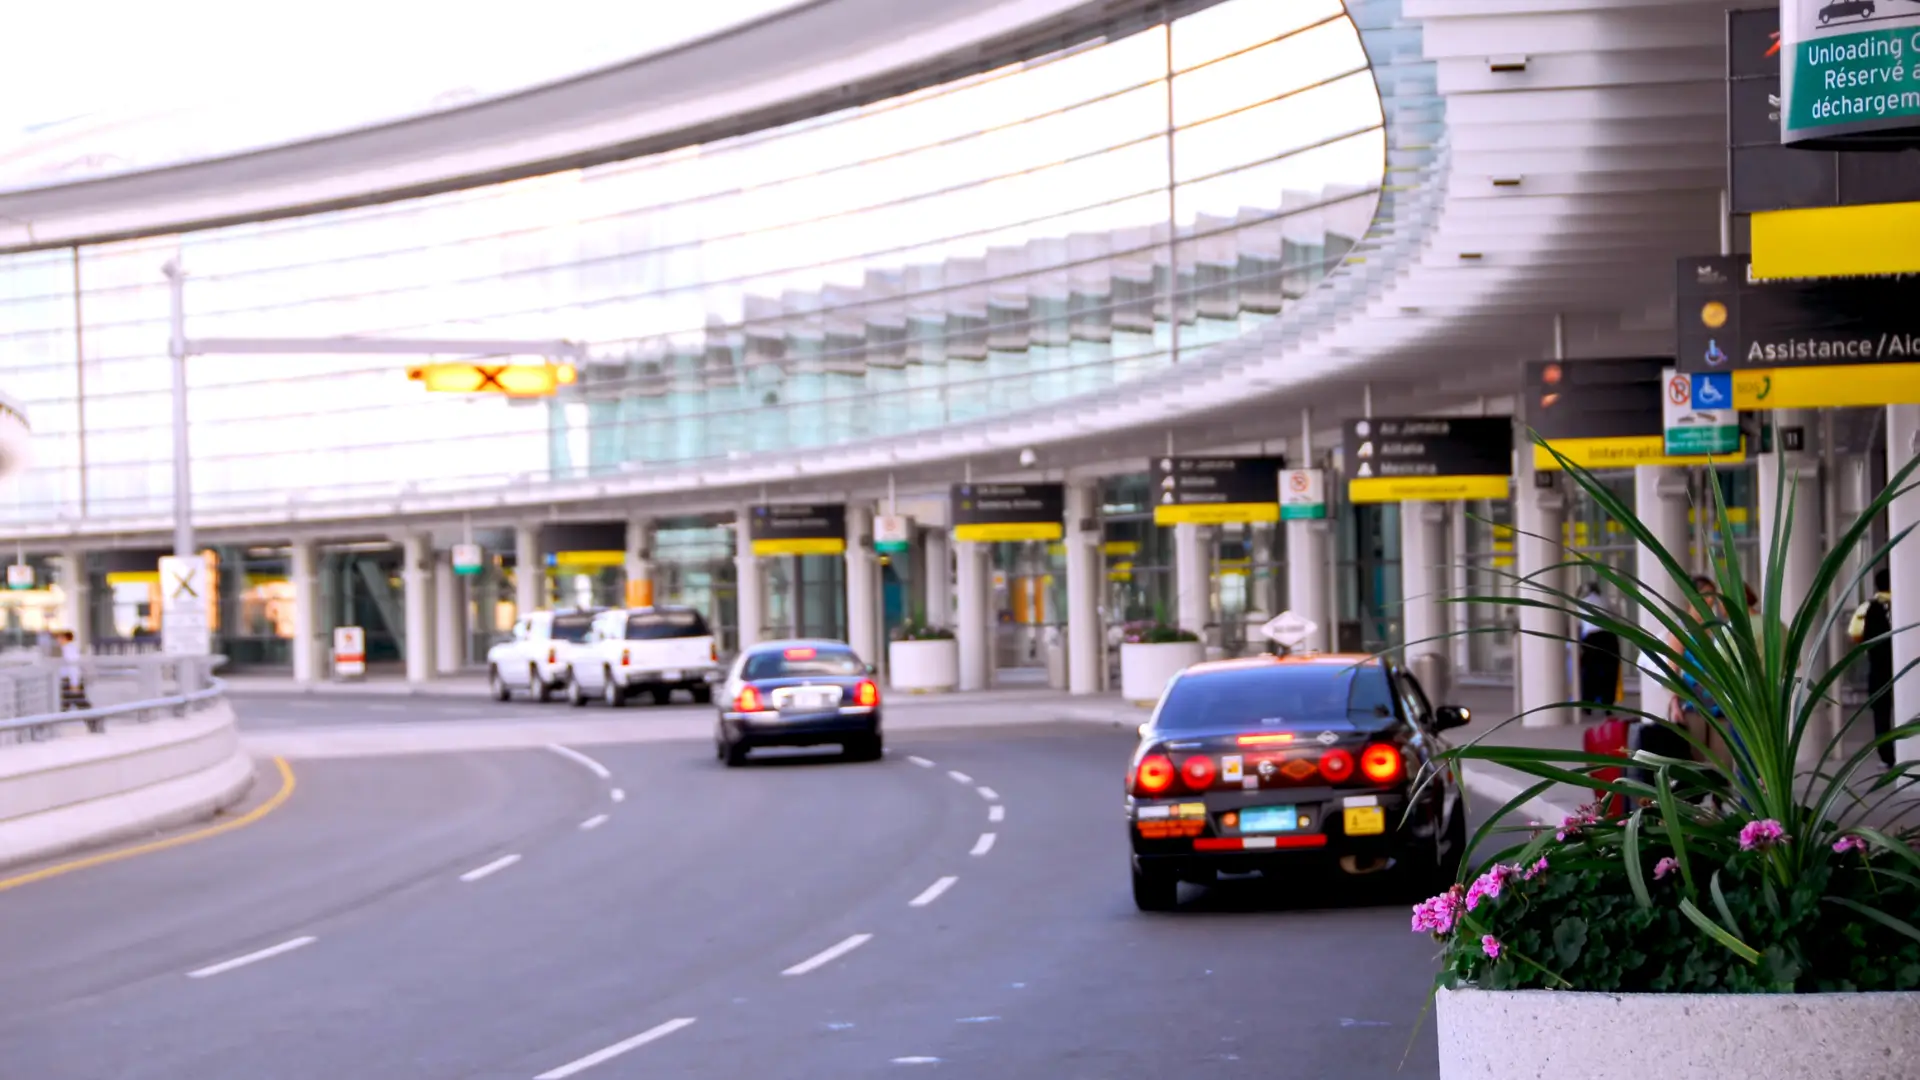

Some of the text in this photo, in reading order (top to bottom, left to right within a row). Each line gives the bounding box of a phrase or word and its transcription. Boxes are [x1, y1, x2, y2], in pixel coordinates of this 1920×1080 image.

[1808, 37, 1902, 66] Unloading
[1825, 60, 1904, 90] Réservé
[1812, 91, 1920, 119] déchargem
[1747, 338, 1872, 362] Assistance
